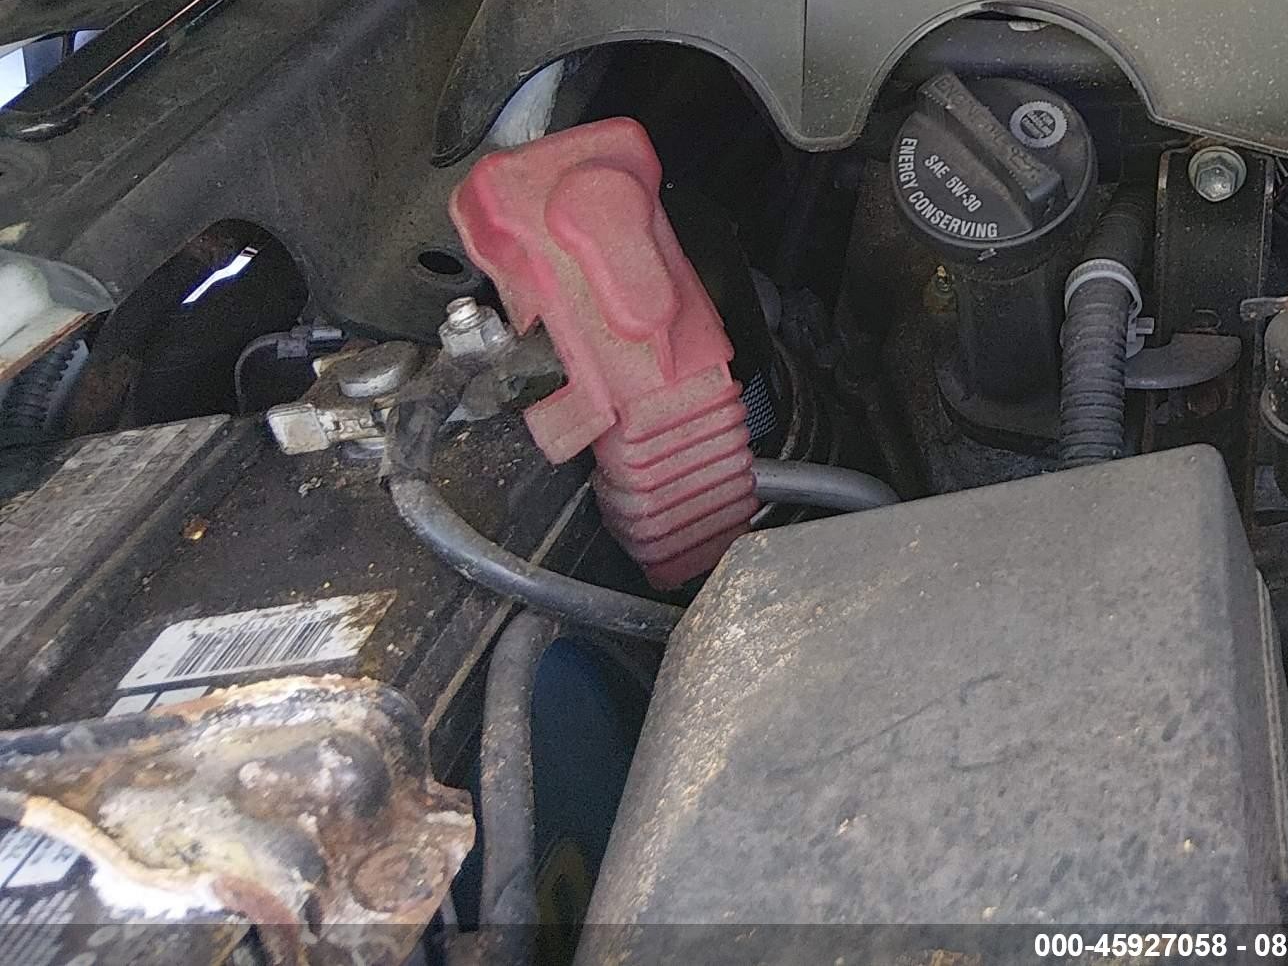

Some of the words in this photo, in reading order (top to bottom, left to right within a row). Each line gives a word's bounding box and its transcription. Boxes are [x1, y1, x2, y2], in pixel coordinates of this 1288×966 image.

[898, 137, 918, 190] ENERGY
[908, 190, 998, 238] CONSERVING
[924, 154, 950, 179] SAE
[946, 174, 982, 213] 5W-30
